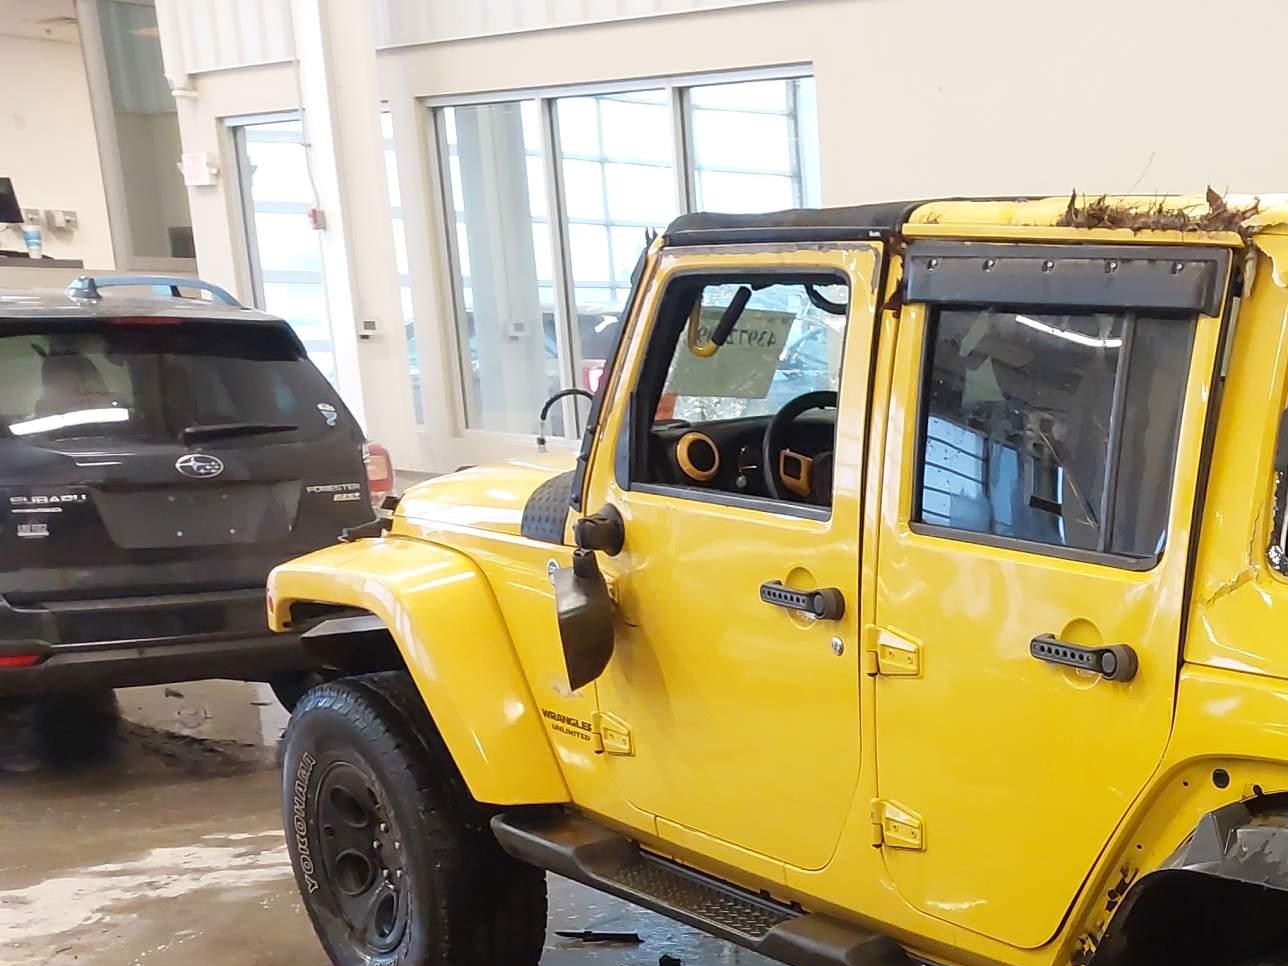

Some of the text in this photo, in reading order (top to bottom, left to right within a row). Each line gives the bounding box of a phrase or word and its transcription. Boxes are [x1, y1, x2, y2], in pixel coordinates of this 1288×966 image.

[10, 494, 87, 505] SUBARU
[541, 708, 592, 732] WRANGLE
[552, 724, 591, 741] UNLIMITED
[293, 751, 317, 894] YOKOHAMA
